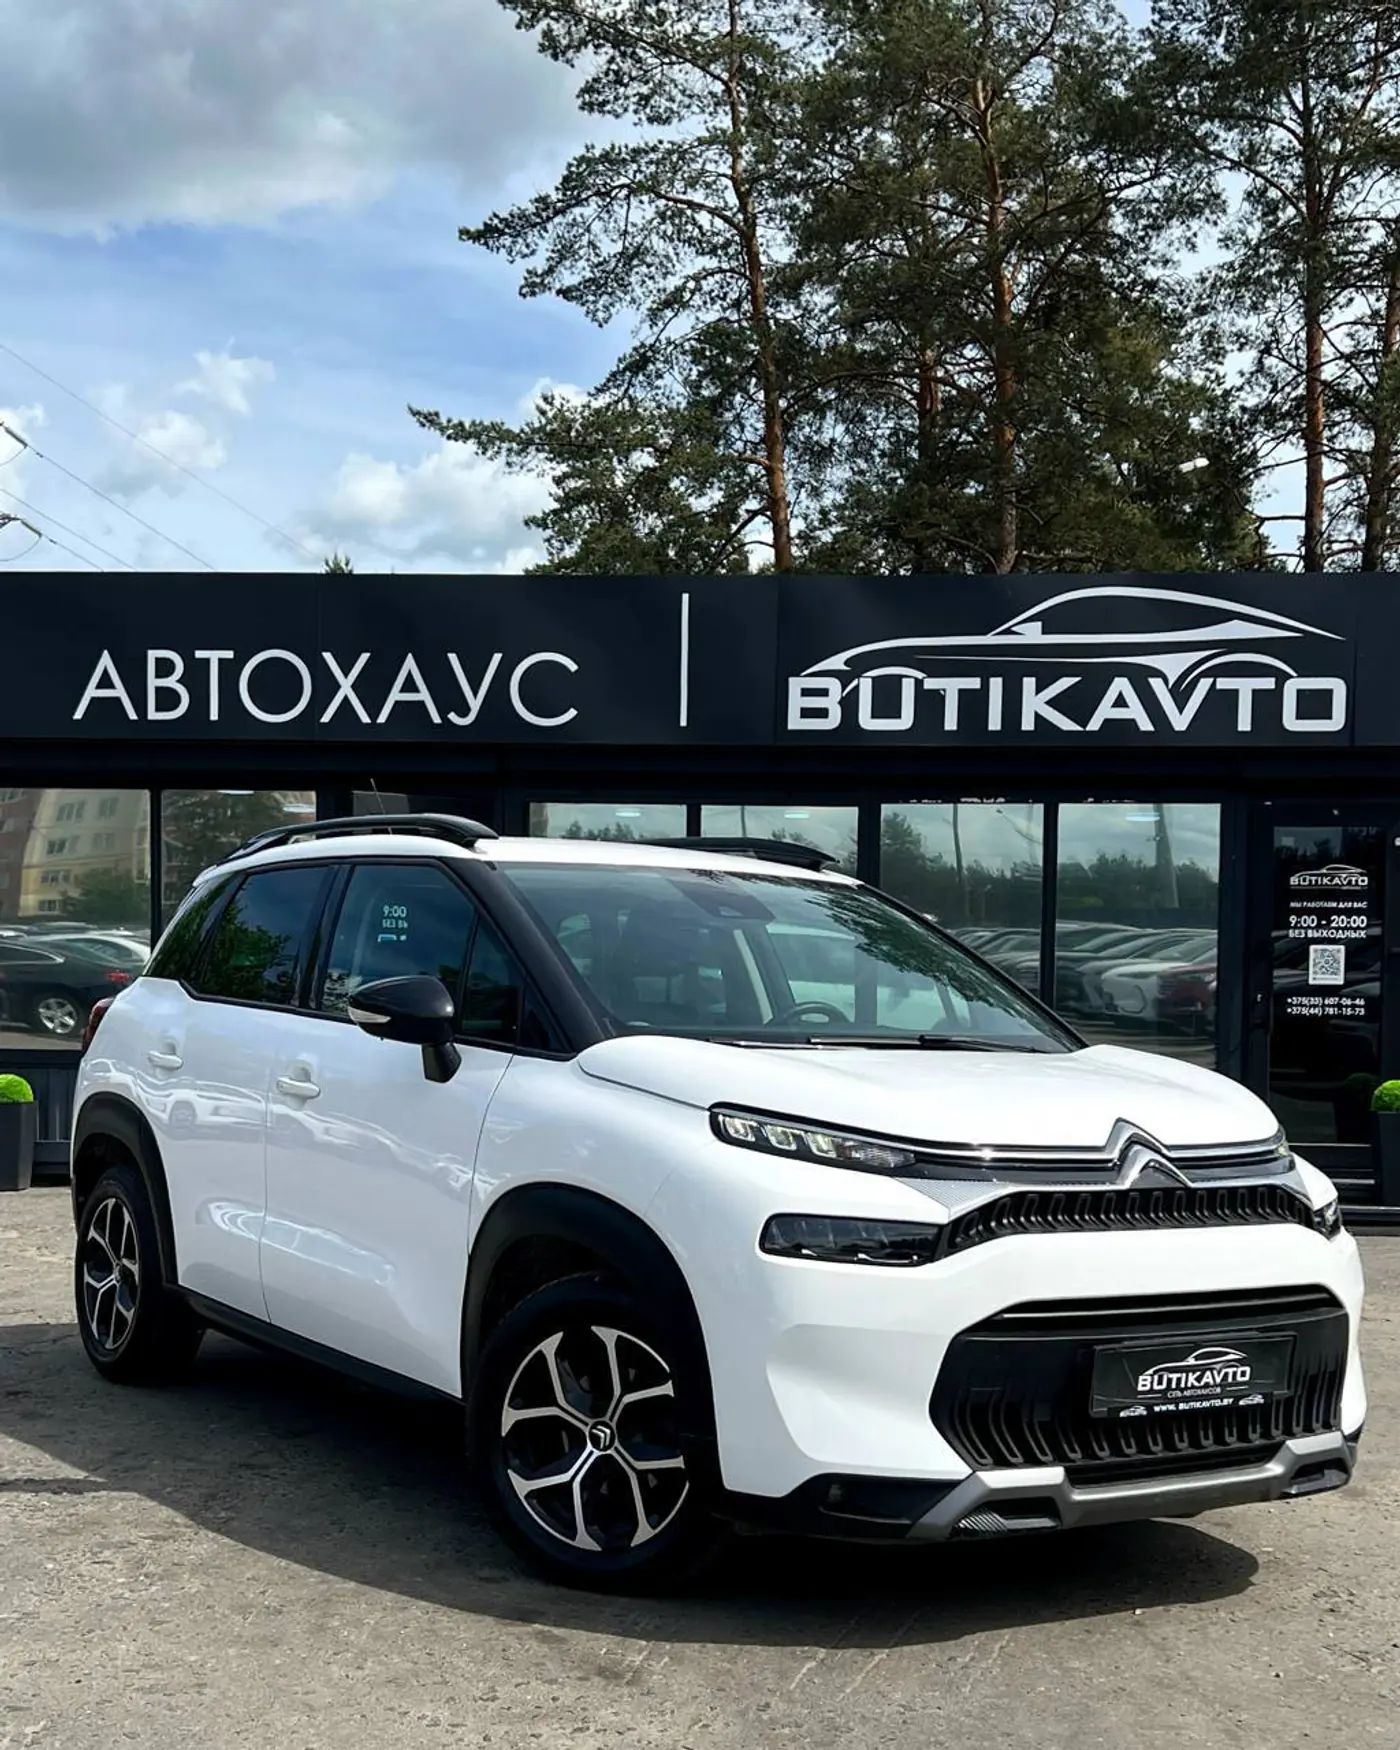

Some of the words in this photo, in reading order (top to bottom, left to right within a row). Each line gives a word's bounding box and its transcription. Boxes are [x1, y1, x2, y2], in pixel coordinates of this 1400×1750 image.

[72, 648, 579, 727] АВТОХАУС
[786, 674, 1347, 733] BUTIKAVTO
[1289, 876, 1369, 886] BUTIKAVTO
[1289, 915, 1317, 927] 9:00
[1330, 915, 1367, 928] 20:00
[1289, 929, 1305, 938] БЕЗ
[1307, 929, 1367, 938] ВЫХОДНЫХ
[1137, 1366, 1251, 1391] BUTIKAVTO
